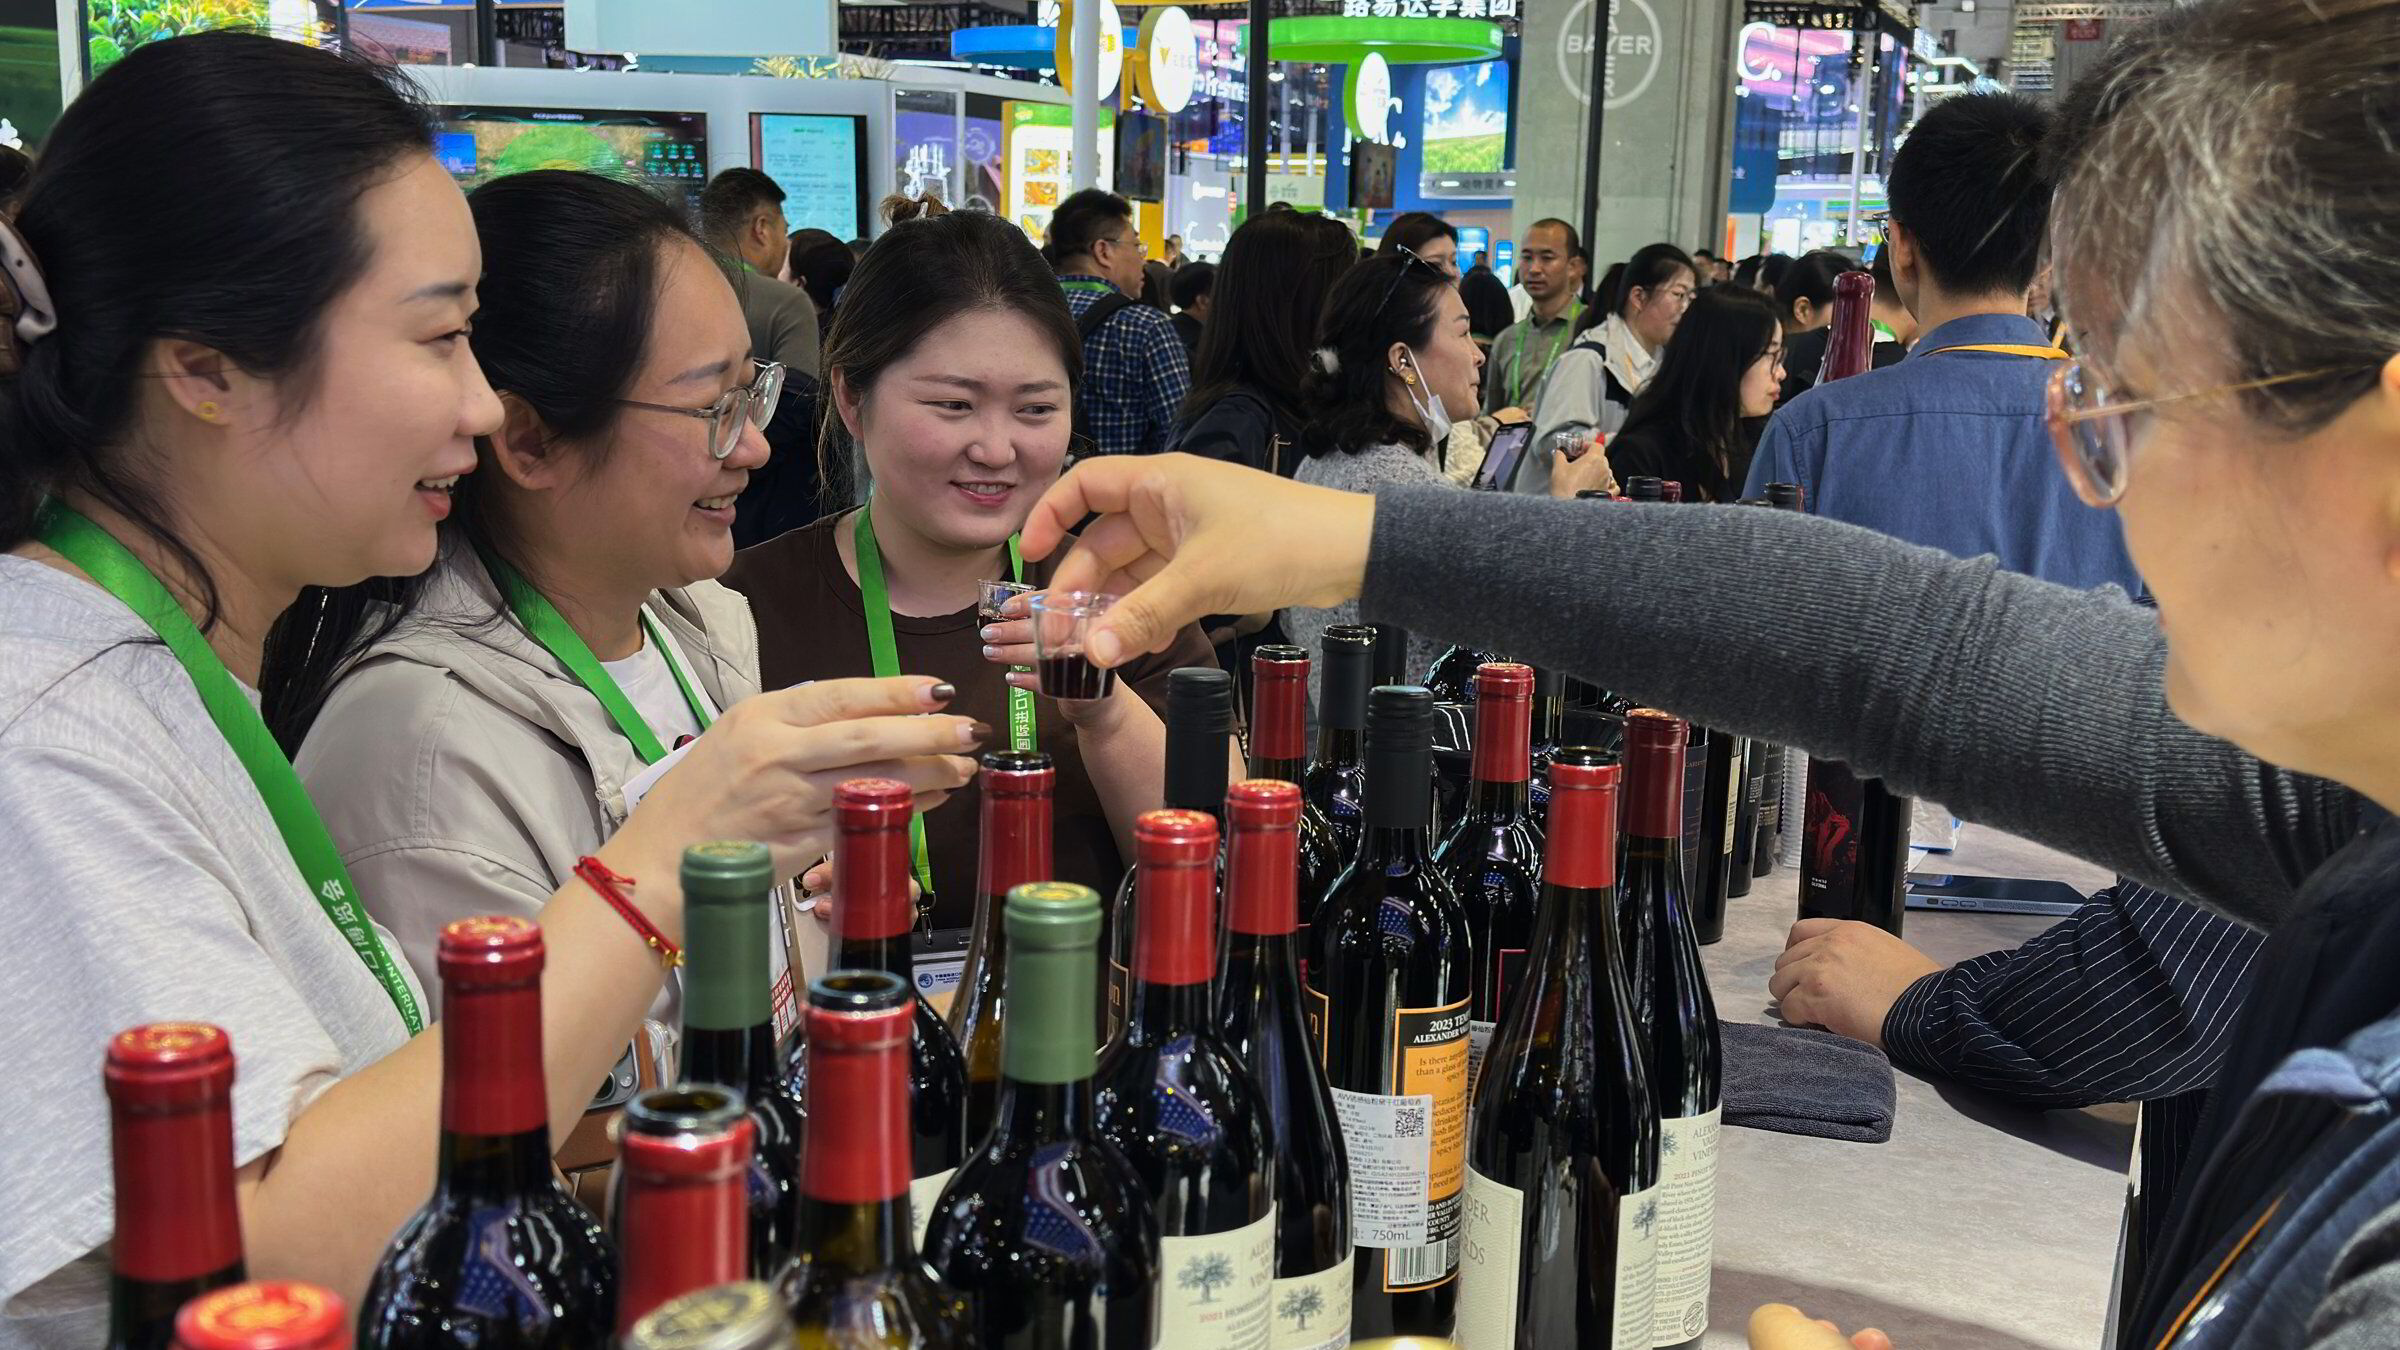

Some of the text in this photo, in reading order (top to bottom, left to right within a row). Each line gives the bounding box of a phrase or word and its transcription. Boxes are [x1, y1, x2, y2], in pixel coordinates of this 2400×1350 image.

[1430, 1018, 1453, 1032] 2023
[1413, 1028, 1460, 1043] ALEXANDER
[1416, 1066, 1434, 1076] than
[1372, 1229, 1411, 1241] 750mL
